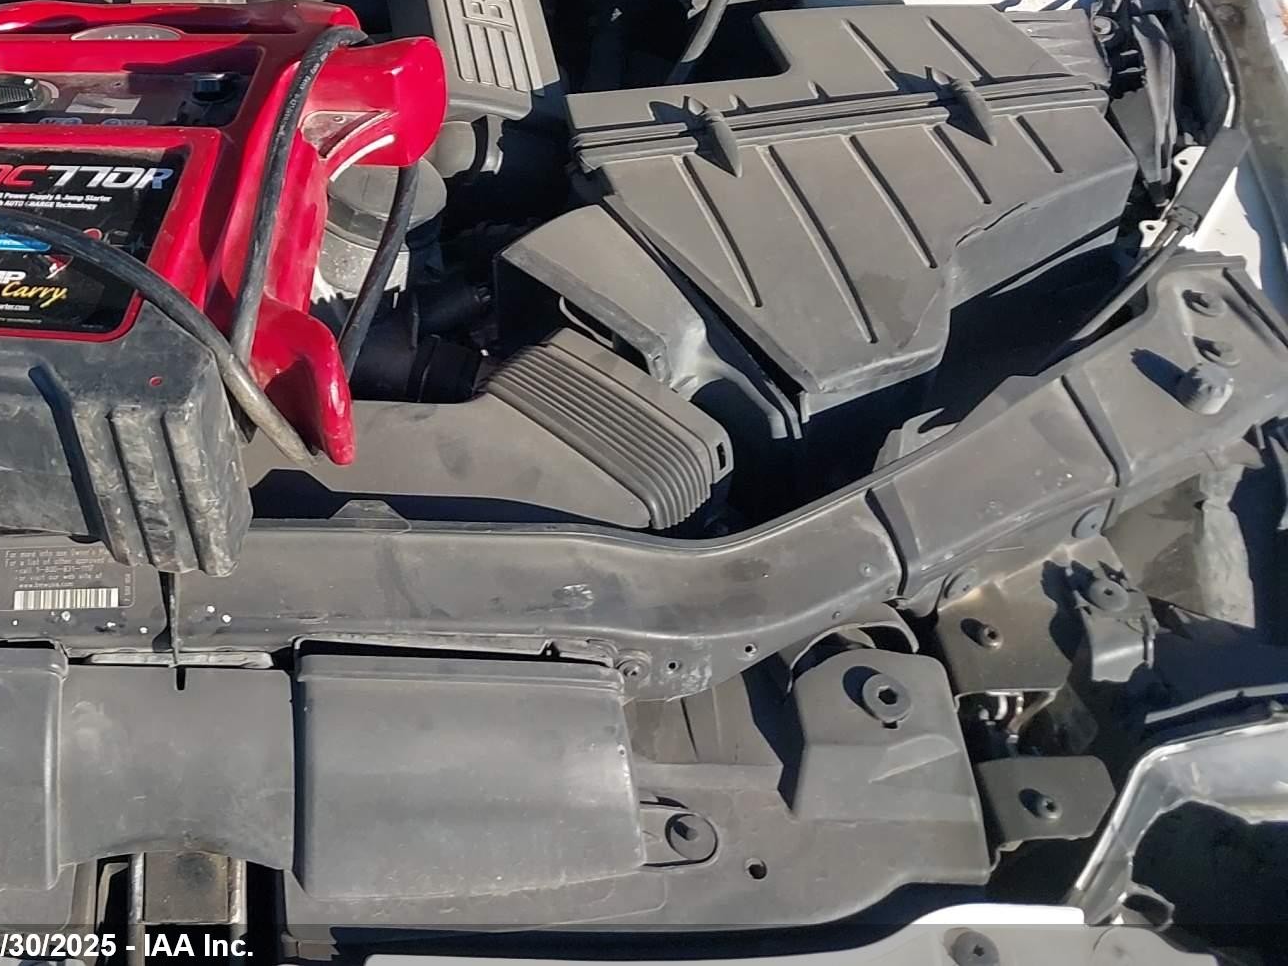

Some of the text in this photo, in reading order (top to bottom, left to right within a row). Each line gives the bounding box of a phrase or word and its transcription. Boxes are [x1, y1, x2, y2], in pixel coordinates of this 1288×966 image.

[4, 192, 28, 200] Power
[28, 193, 54, 202] Supply
[62, 194, 84, 203] Jump
[85, 194, 112, 203] Starter
[55, 201, 98, 210] Technology
[1, 281, 68, 308] Carry
